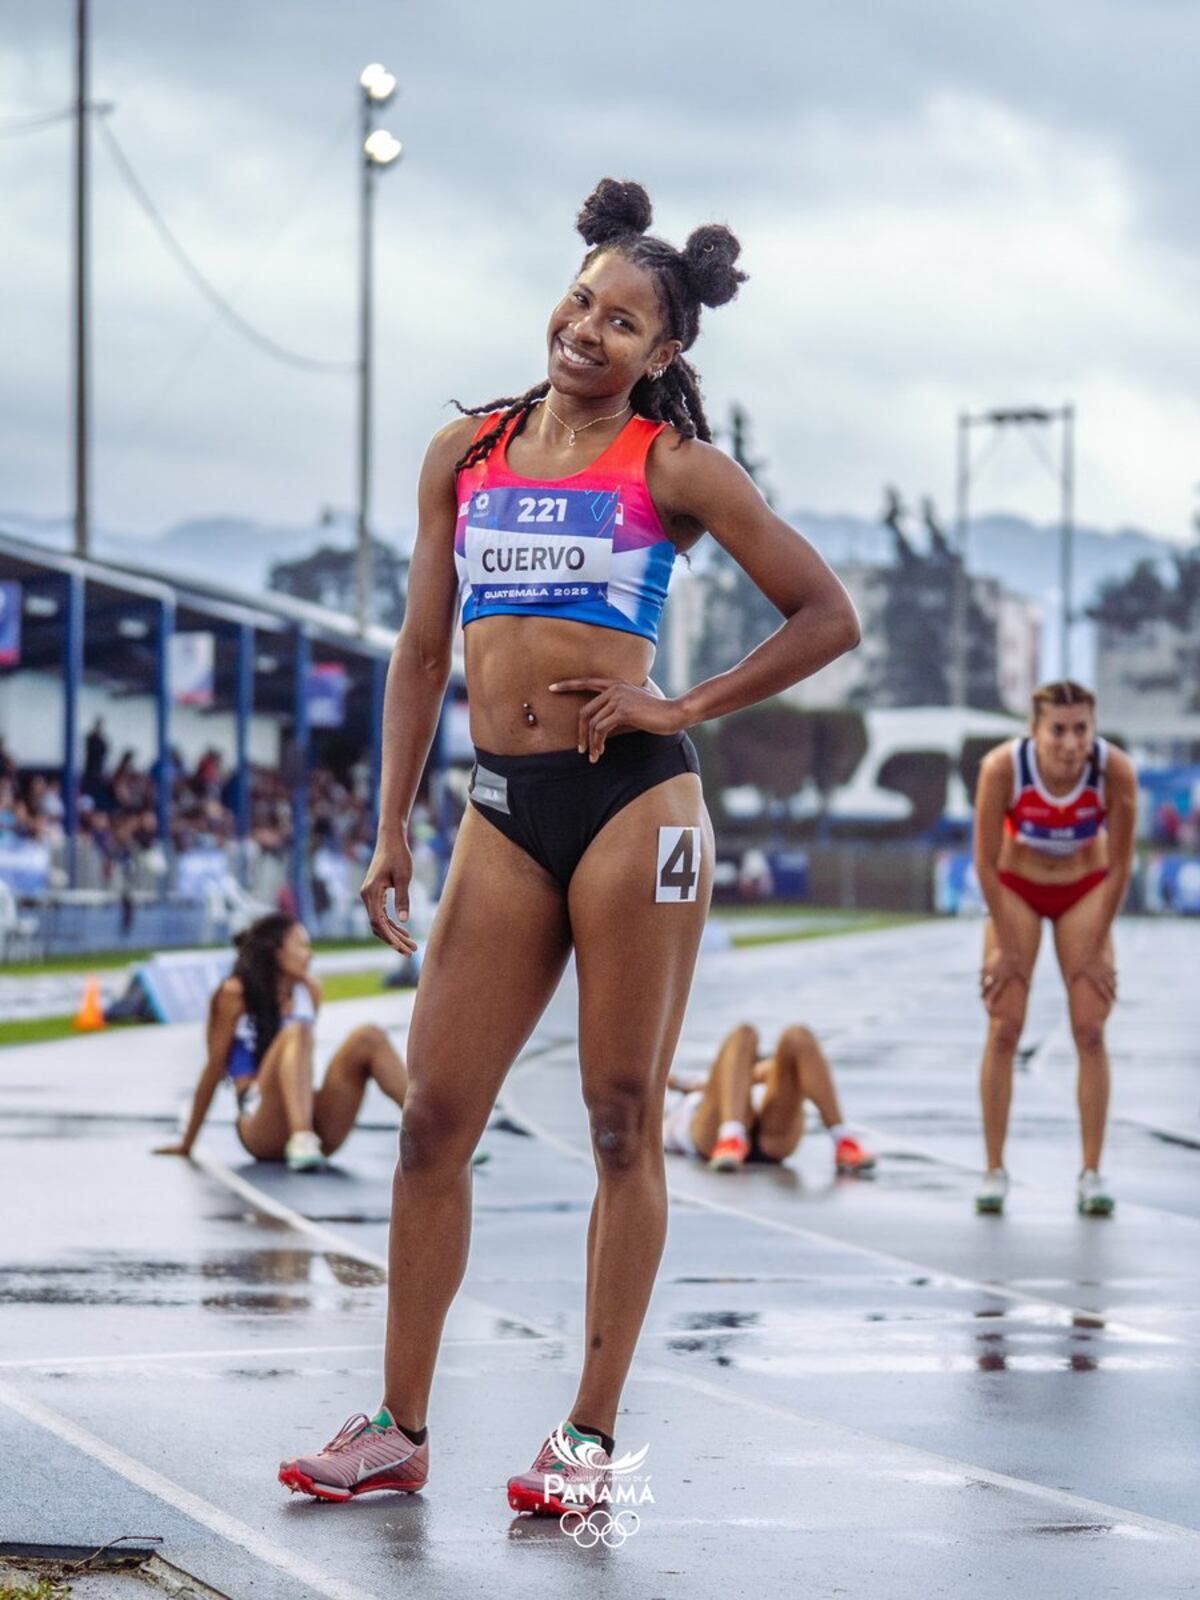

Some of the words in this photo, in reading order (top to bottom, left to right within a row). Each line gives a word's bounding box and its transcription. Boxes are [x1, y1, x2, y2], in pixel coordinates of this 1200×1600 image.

[516, 497, 568, 523] 221
[482, 546, 585, 573] CUERVO
[484, 588, 549, 599] GUATEMALA
[553, 587, 589, 597] 2025
[660, 830, 696, 900] 4
